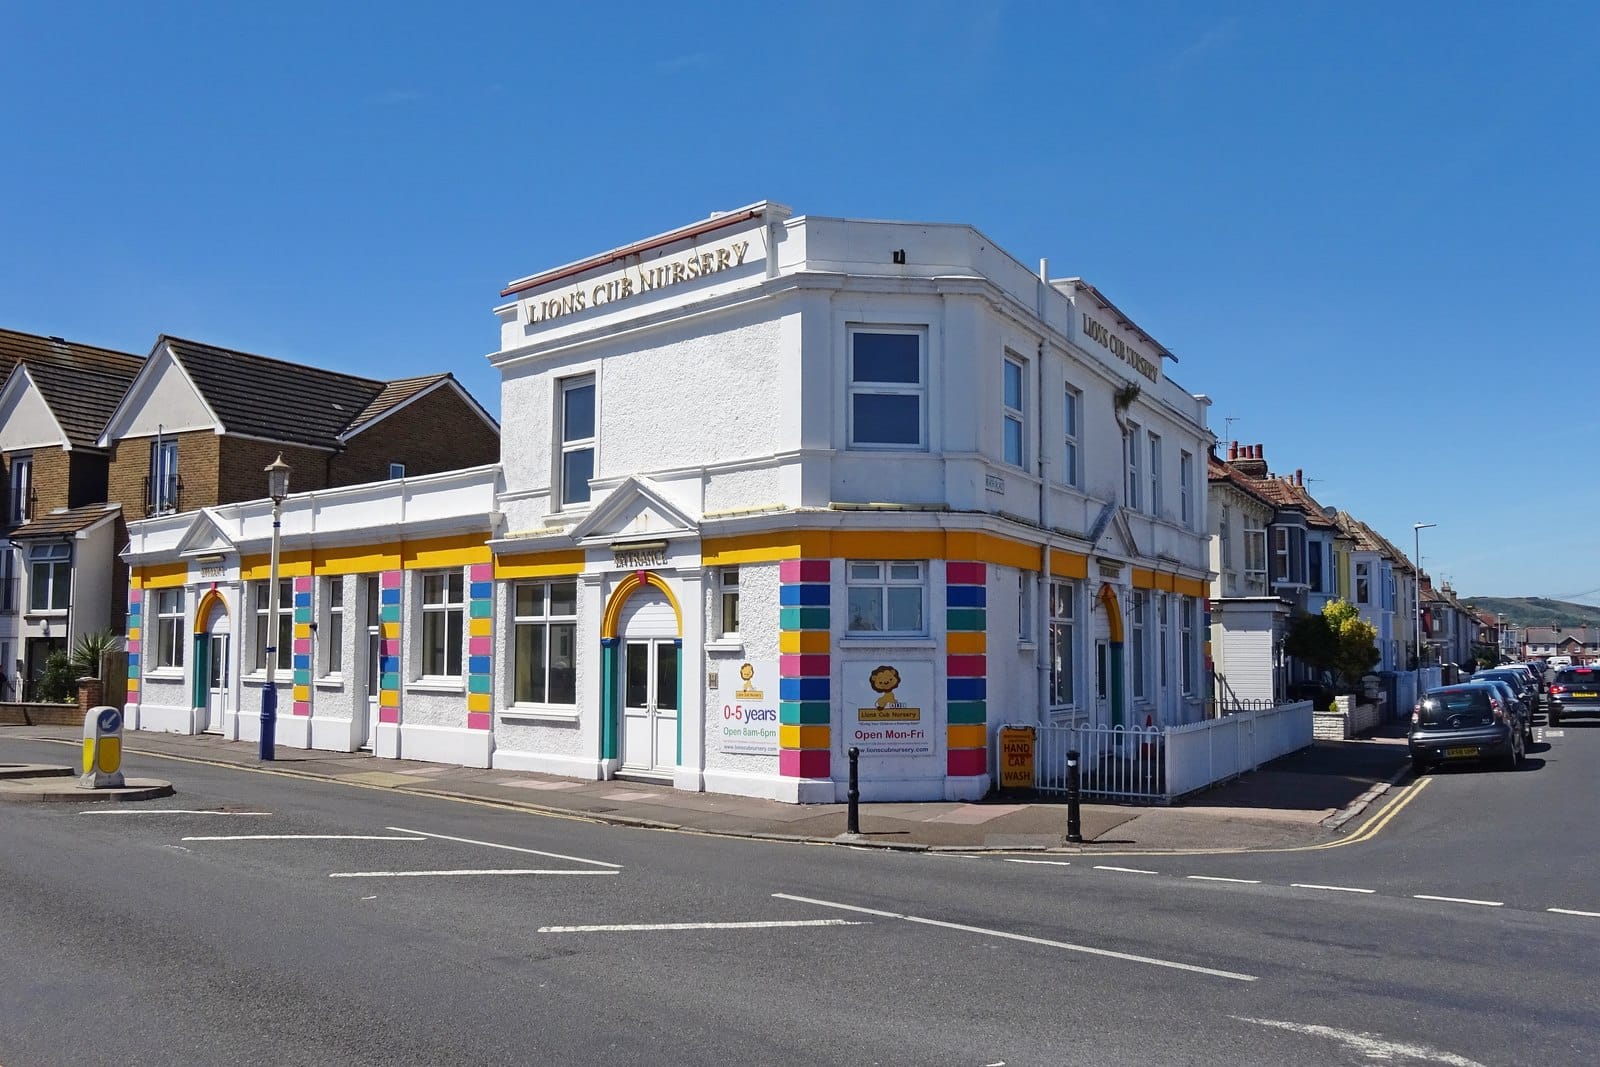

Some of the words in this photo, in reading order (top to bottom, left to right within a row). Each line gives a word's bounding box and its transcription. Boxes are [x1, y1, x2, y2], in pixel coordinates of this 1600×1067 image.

[528, 291, 586, 325] LIONS
[592, 277, 633, 307] CUB
[639, 241, 750, 294] NURSERY
[614, 550, 669, 568] ENTRANCE
[724, 705, 742, 720] 0-5
[744, 709, 776, 724] years
[723, 727, 741, 738] Open
[743, 727, 776, 738] 8am-6pm
[854, 730, 882, 741] Open
[885, 729, 925, 739] Mon-Fri
[1003, 743, 1030, 753] HAND
[1008, 757, 1026, 767] CAR
[1004, 771, 1031, 781] WASH
